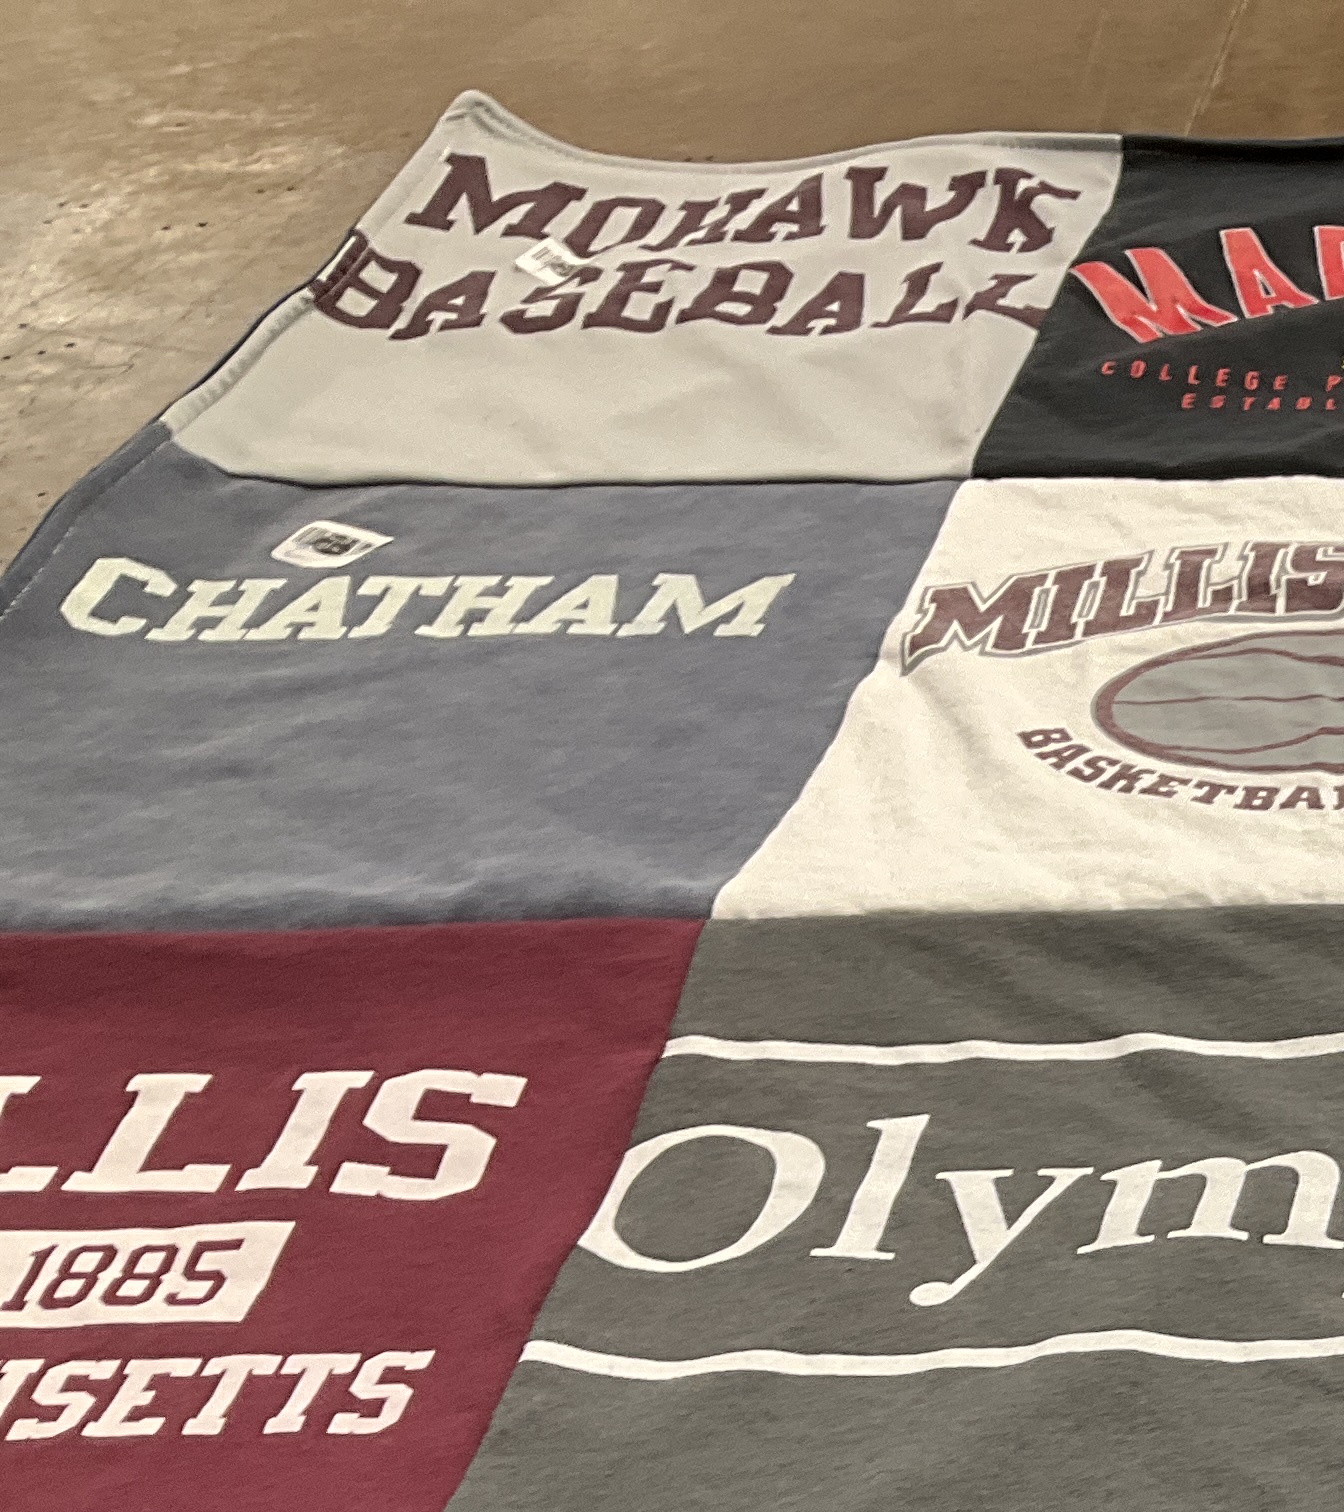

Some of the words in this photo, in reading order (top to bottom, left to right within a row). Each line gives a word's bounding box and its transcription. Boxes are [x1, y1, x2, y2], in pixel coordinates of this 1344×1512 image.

[405, 152, 1081, 258] MOHAWK
[315, 228, 1050, 341] BASEBALL
[1101, 359, 1288, 391] COLLEGE
[58, 557, 796, 642] CHATHAM
[1, 1238, 246, 1312] 1885
